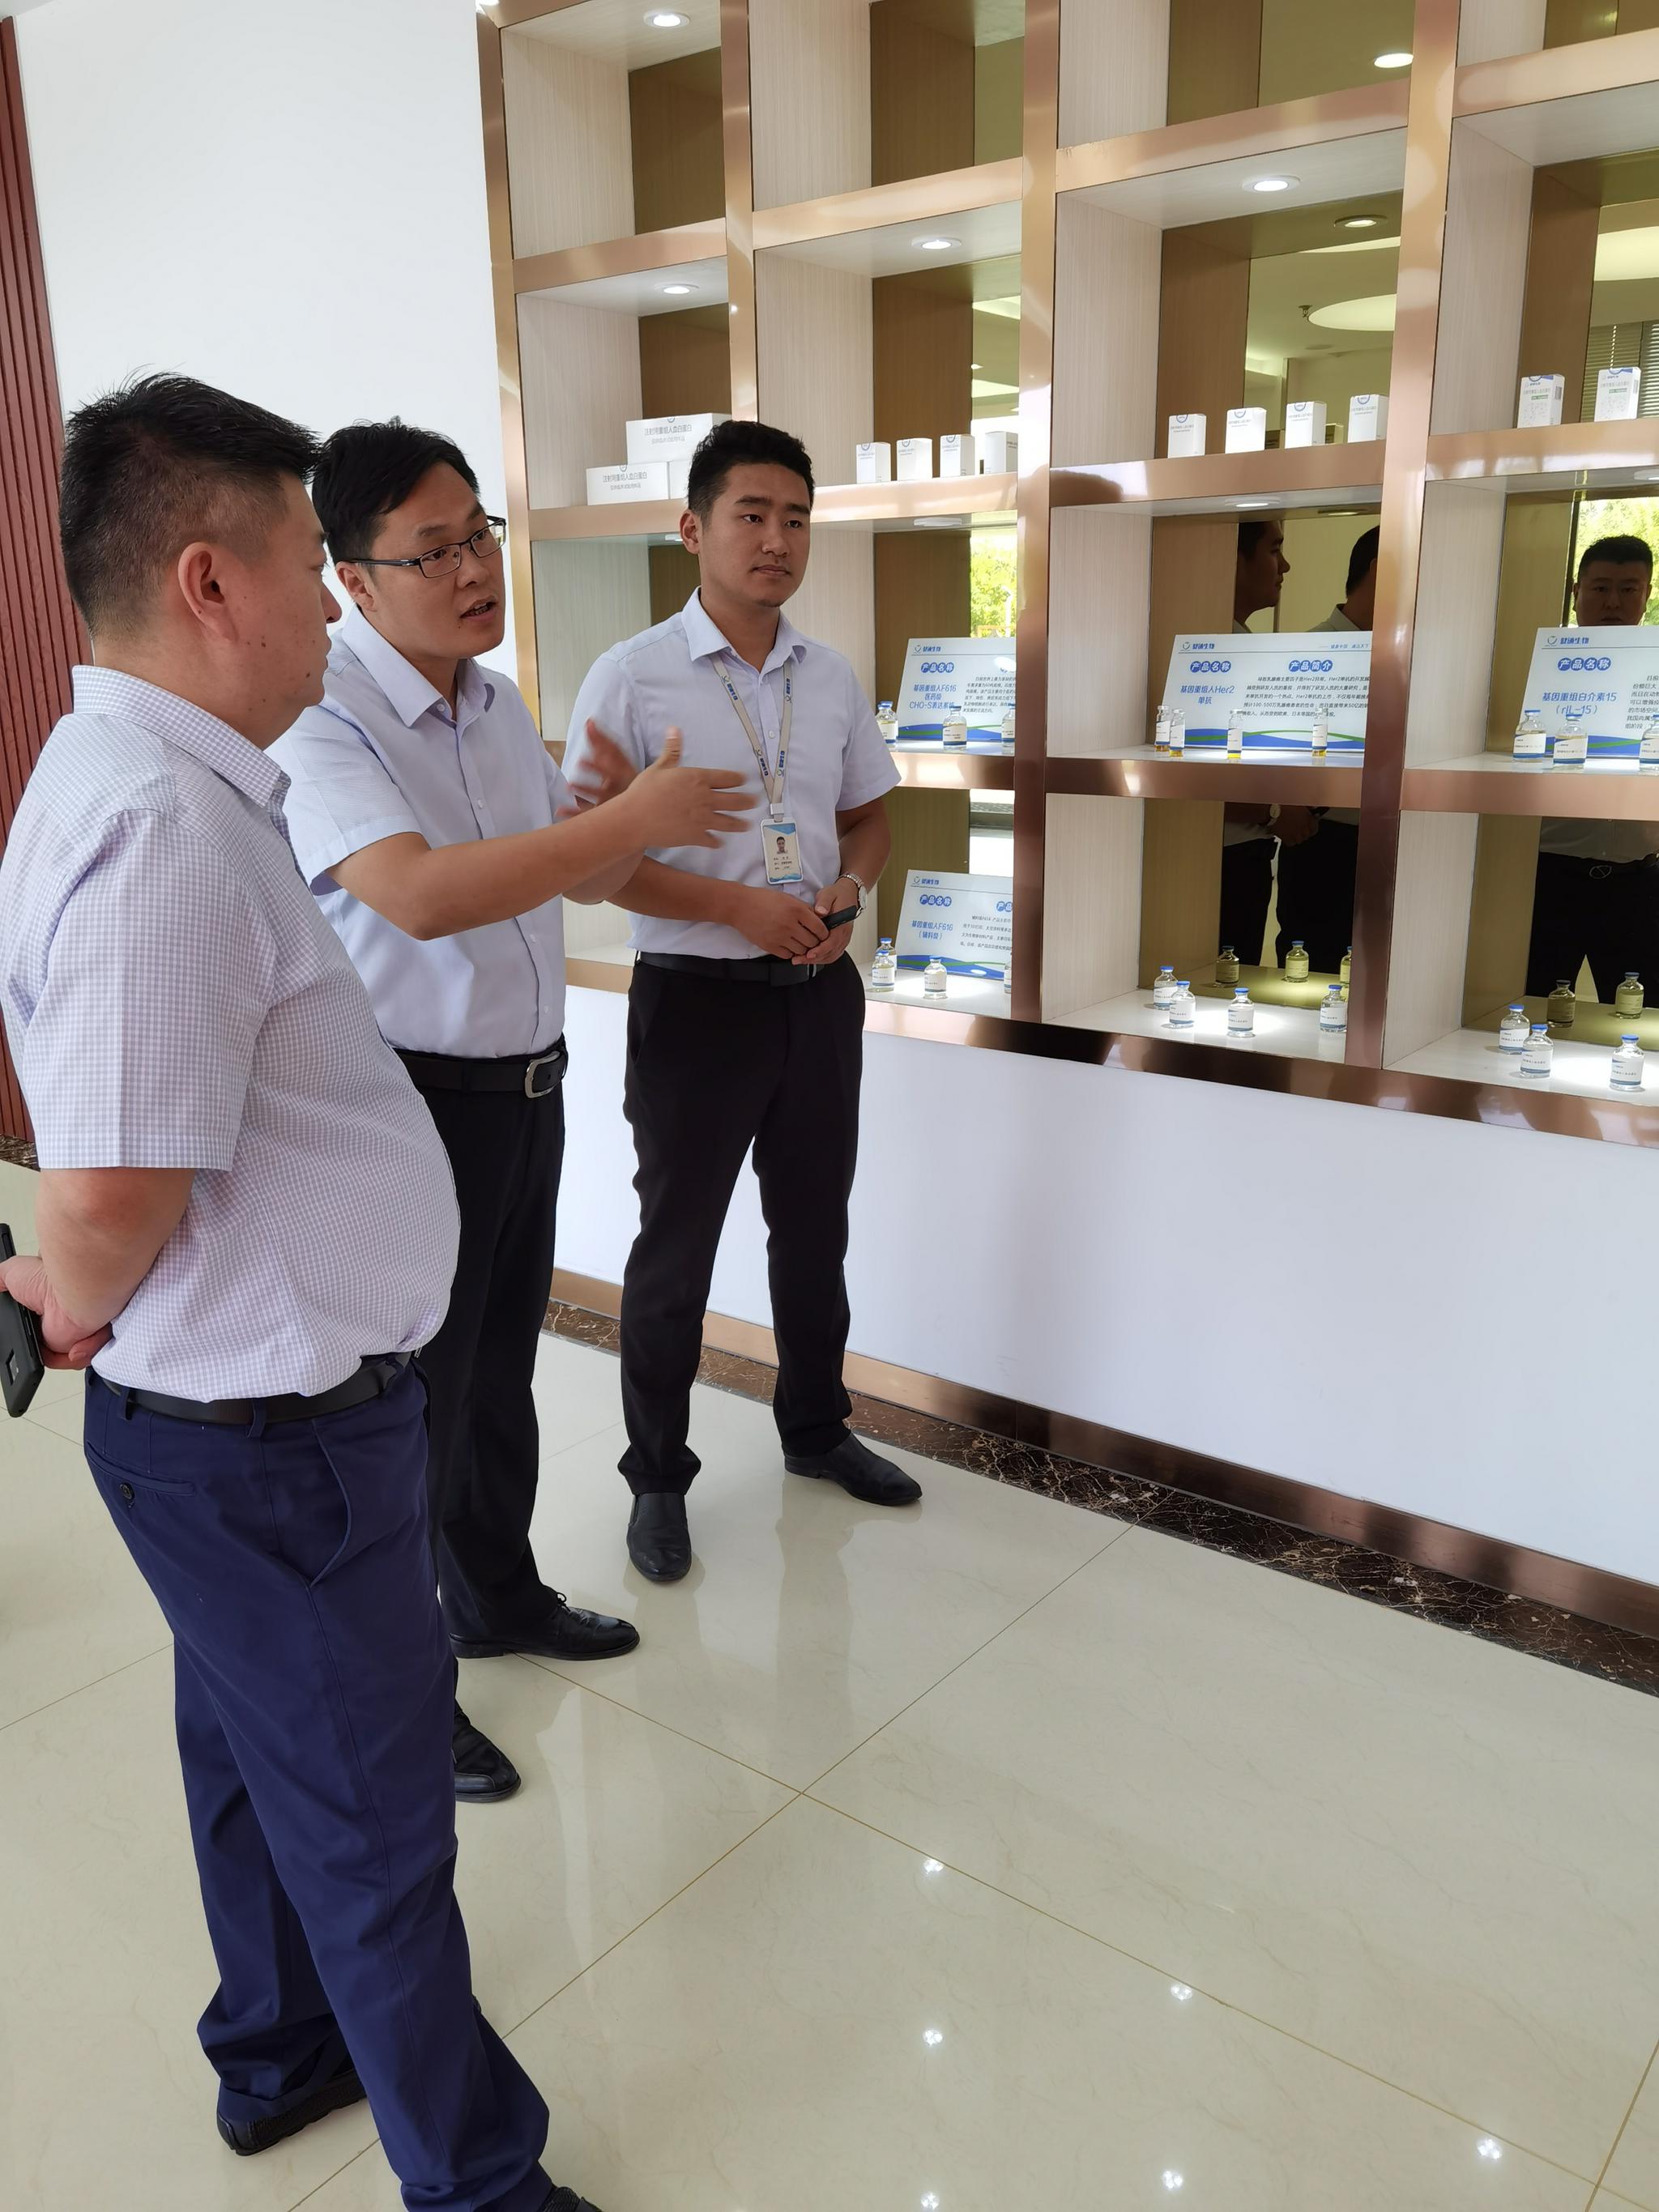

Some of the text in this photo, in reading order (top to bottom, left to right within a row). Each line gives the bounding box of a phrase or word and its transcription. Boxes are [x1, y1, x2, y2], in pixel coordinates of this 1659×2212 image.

[921, 662, 954, 673] 产品名称
[1190, 660, 1231, 673] 产品名称
[1289, 659, 1333, 672] 产品简介
[1558, 657, 1611, 671] 产品名称
[1542, 692, 1618, 701] 基因重组白介素15
[919, 894, 952, 907] 产品名称
